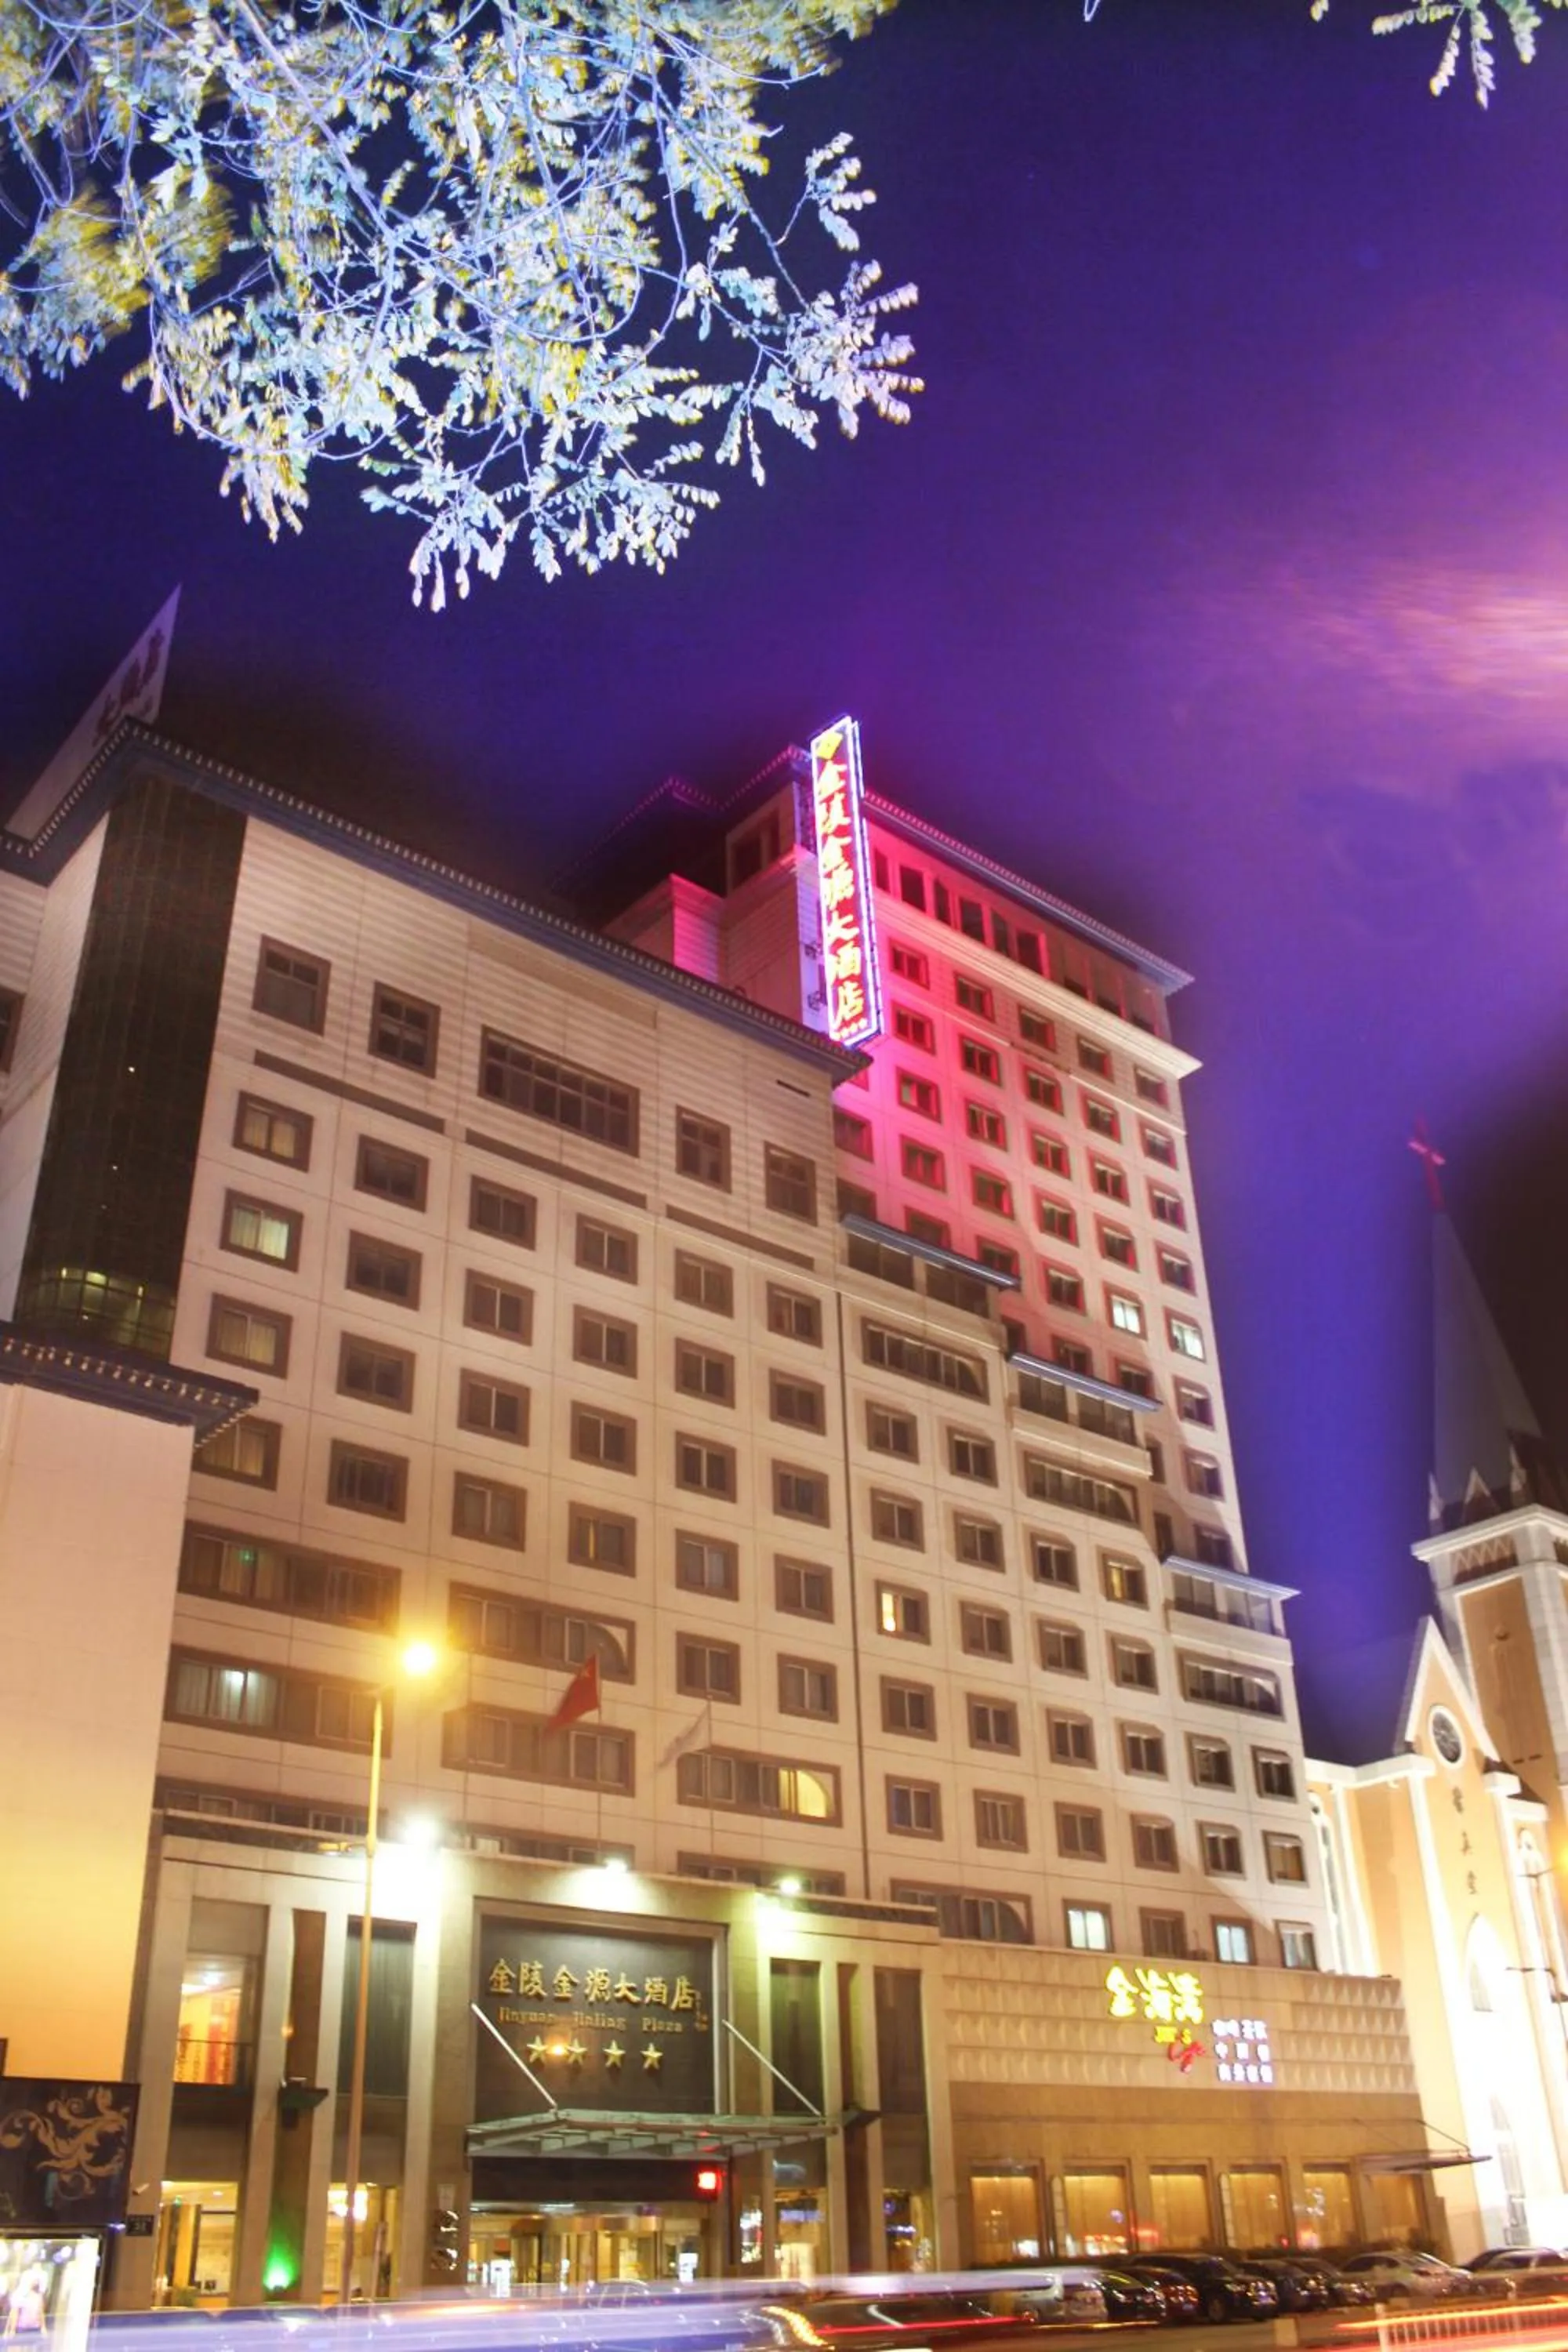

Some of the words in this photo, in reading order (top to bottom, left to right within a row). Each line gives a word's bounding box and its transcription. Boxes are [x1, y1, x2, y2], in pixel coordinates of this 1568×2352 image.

[488, 1958, 697, 2011] 金陵金源大酒店
[642, 2017, 684, 2033] Plaza
